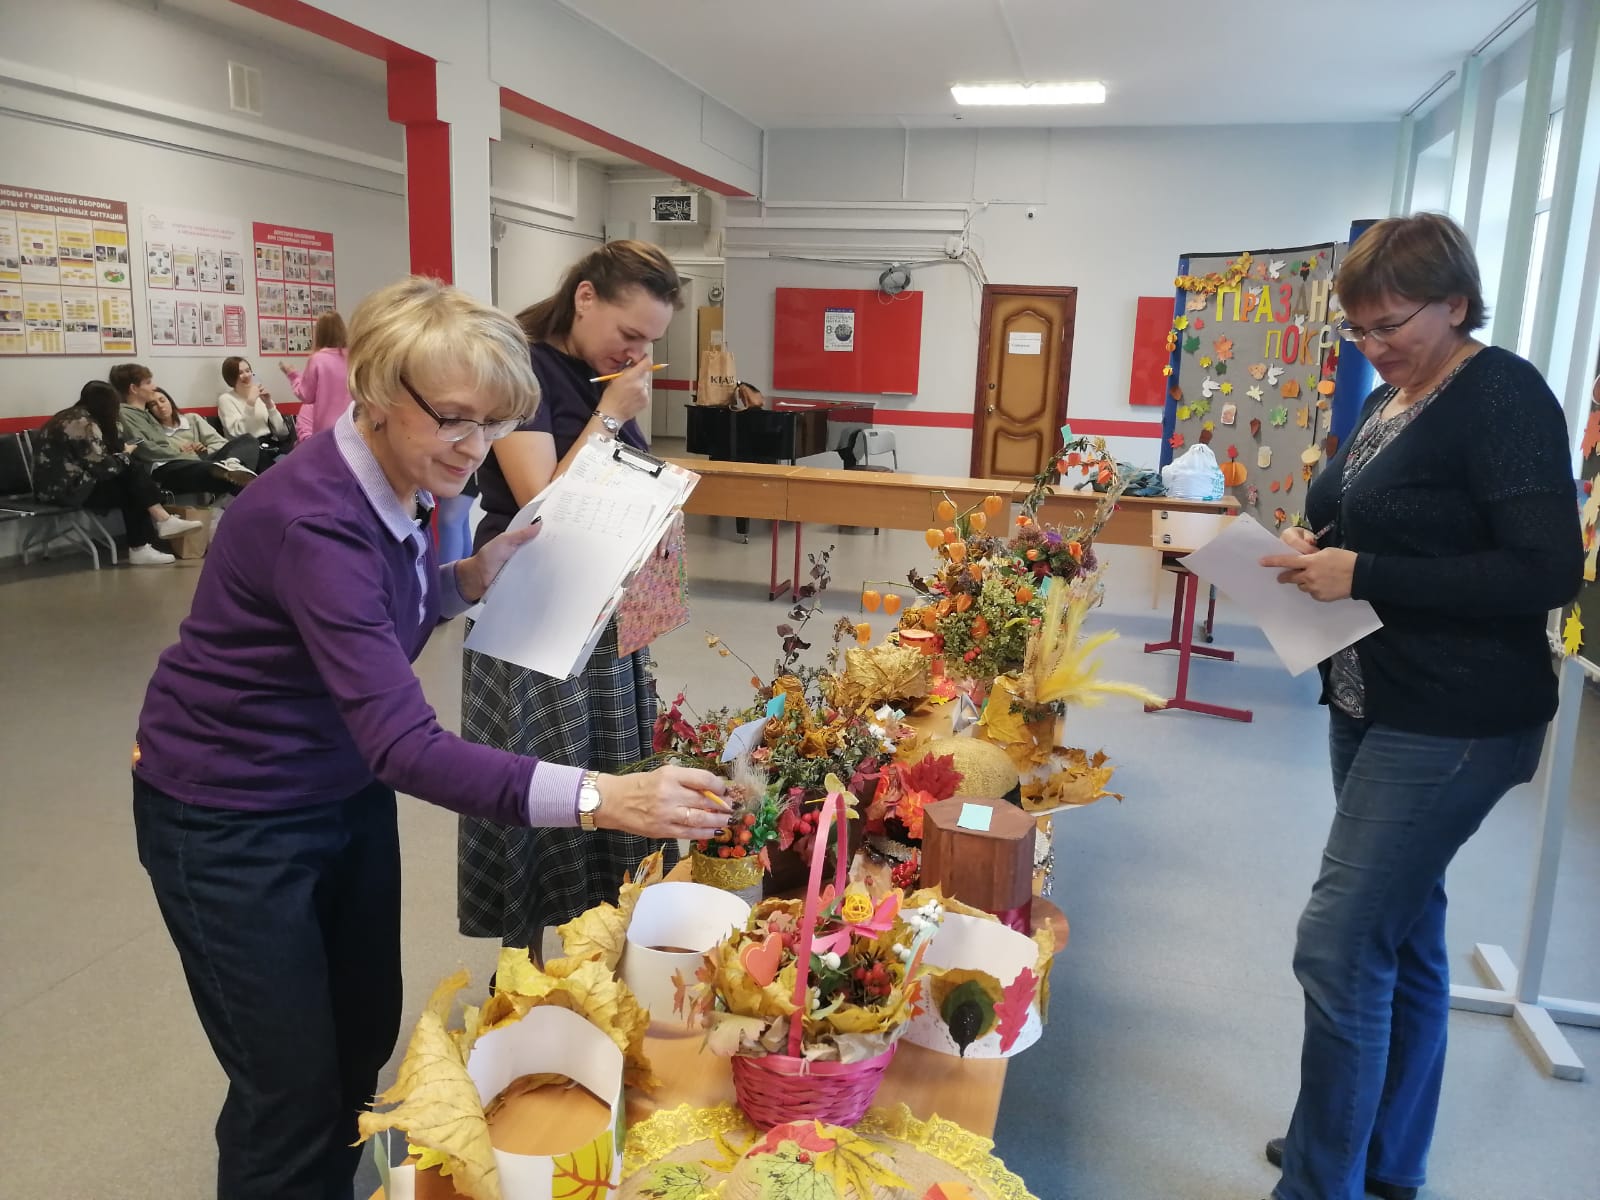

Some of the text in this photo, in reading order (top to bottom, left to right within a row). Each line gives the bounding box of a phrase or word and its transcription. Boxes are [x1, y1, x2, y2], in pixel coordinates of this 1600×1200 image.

[0, 189, 111, 209] НОВЫ ГРАЖДАНСКОЙ ОБОРОНЫ
[0, 199, 18, 208] ИТЫ
[31, 203, 88, 216] ЧРЕЗВЫЧАЙНЫХ
[90, 211, 123, 220] СИТУАЦИЙ
[1264, 325, 1339, 366] ПОКР
